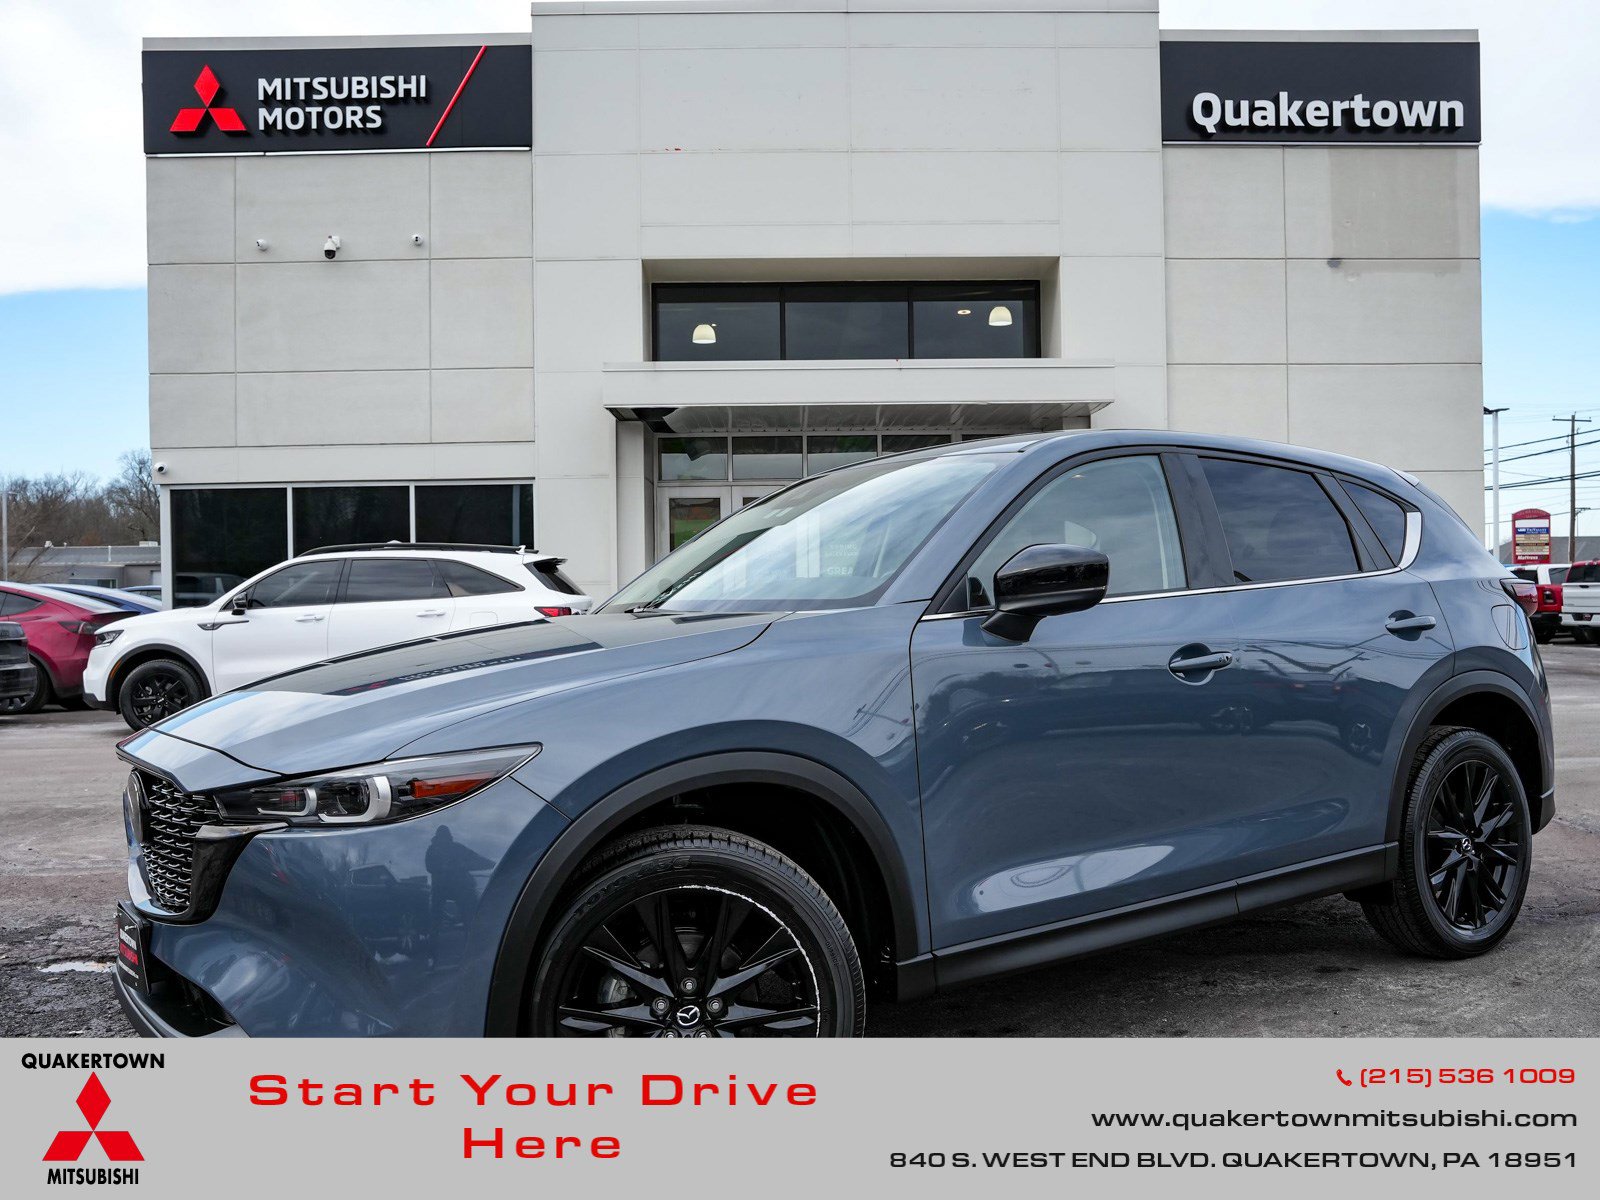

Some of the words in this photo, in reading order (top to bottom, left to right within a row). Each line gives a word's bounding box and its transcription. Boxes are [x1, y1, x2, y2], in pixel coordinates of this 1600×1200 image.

[257, 74, 427, 101] MITSUBISHI
[257, 105, 383, 131] MOTORS
[1192, 91, 1465, 134] Quakertown
